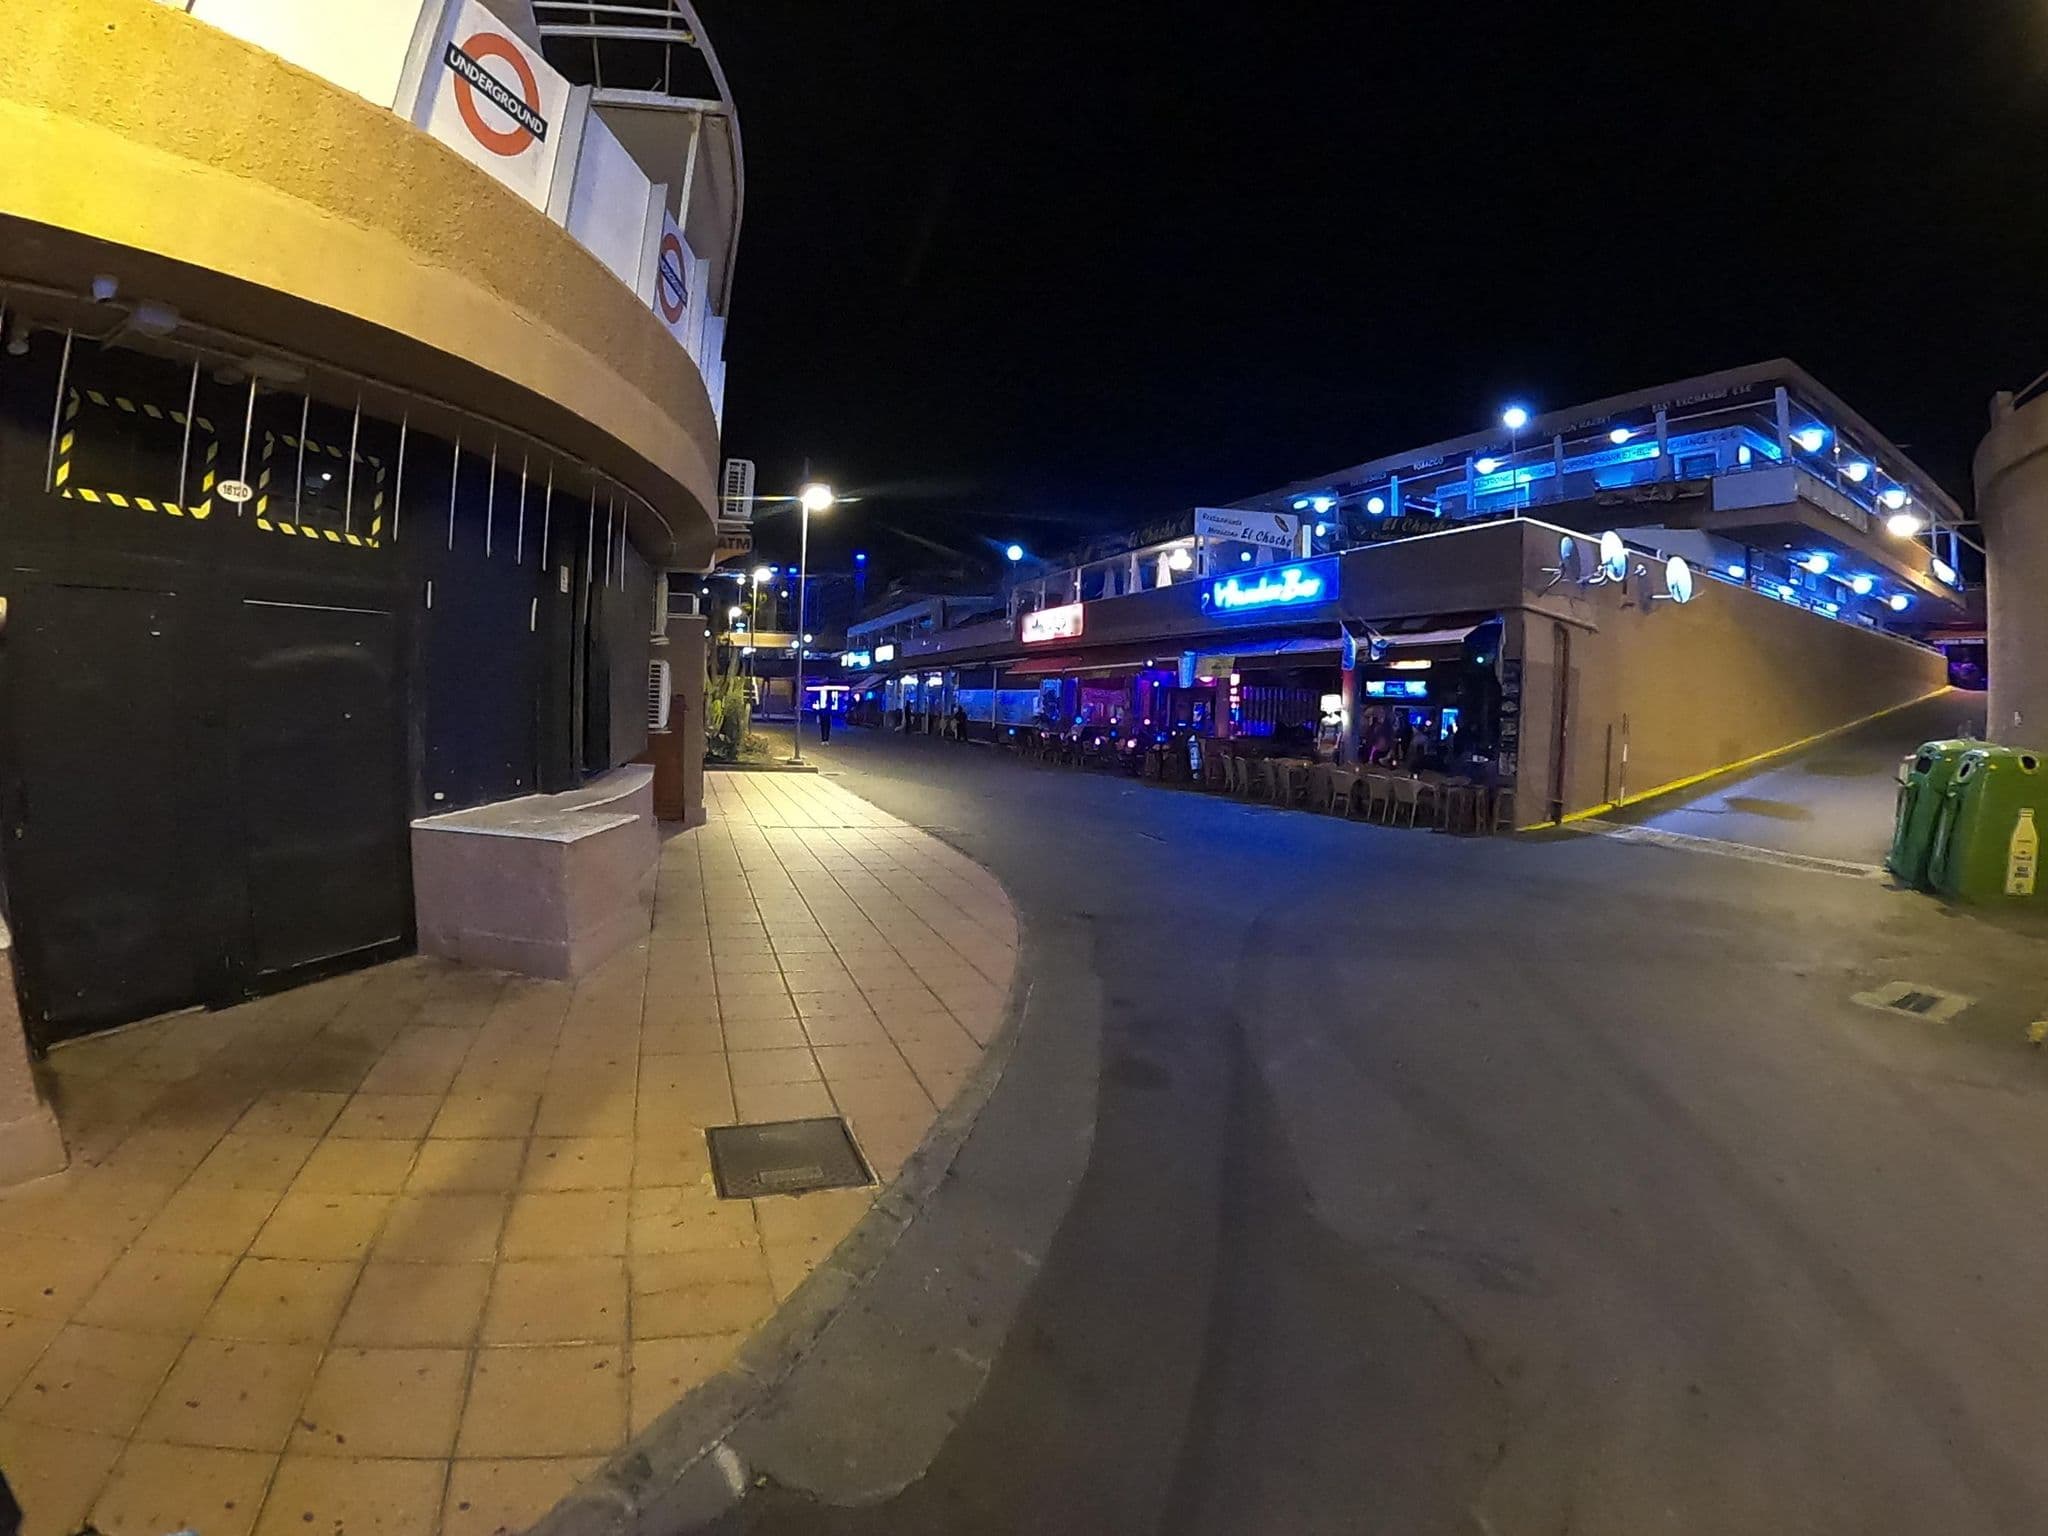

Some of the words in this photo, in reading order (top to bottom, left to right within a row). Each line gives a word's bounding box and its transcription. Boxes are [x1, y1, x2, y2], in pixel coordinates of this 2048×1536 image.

[449, 49, 543, 134] UNDERGROUND
[1240, 527, 1254, 540] El
[718, 537, 750, 550] ATM
